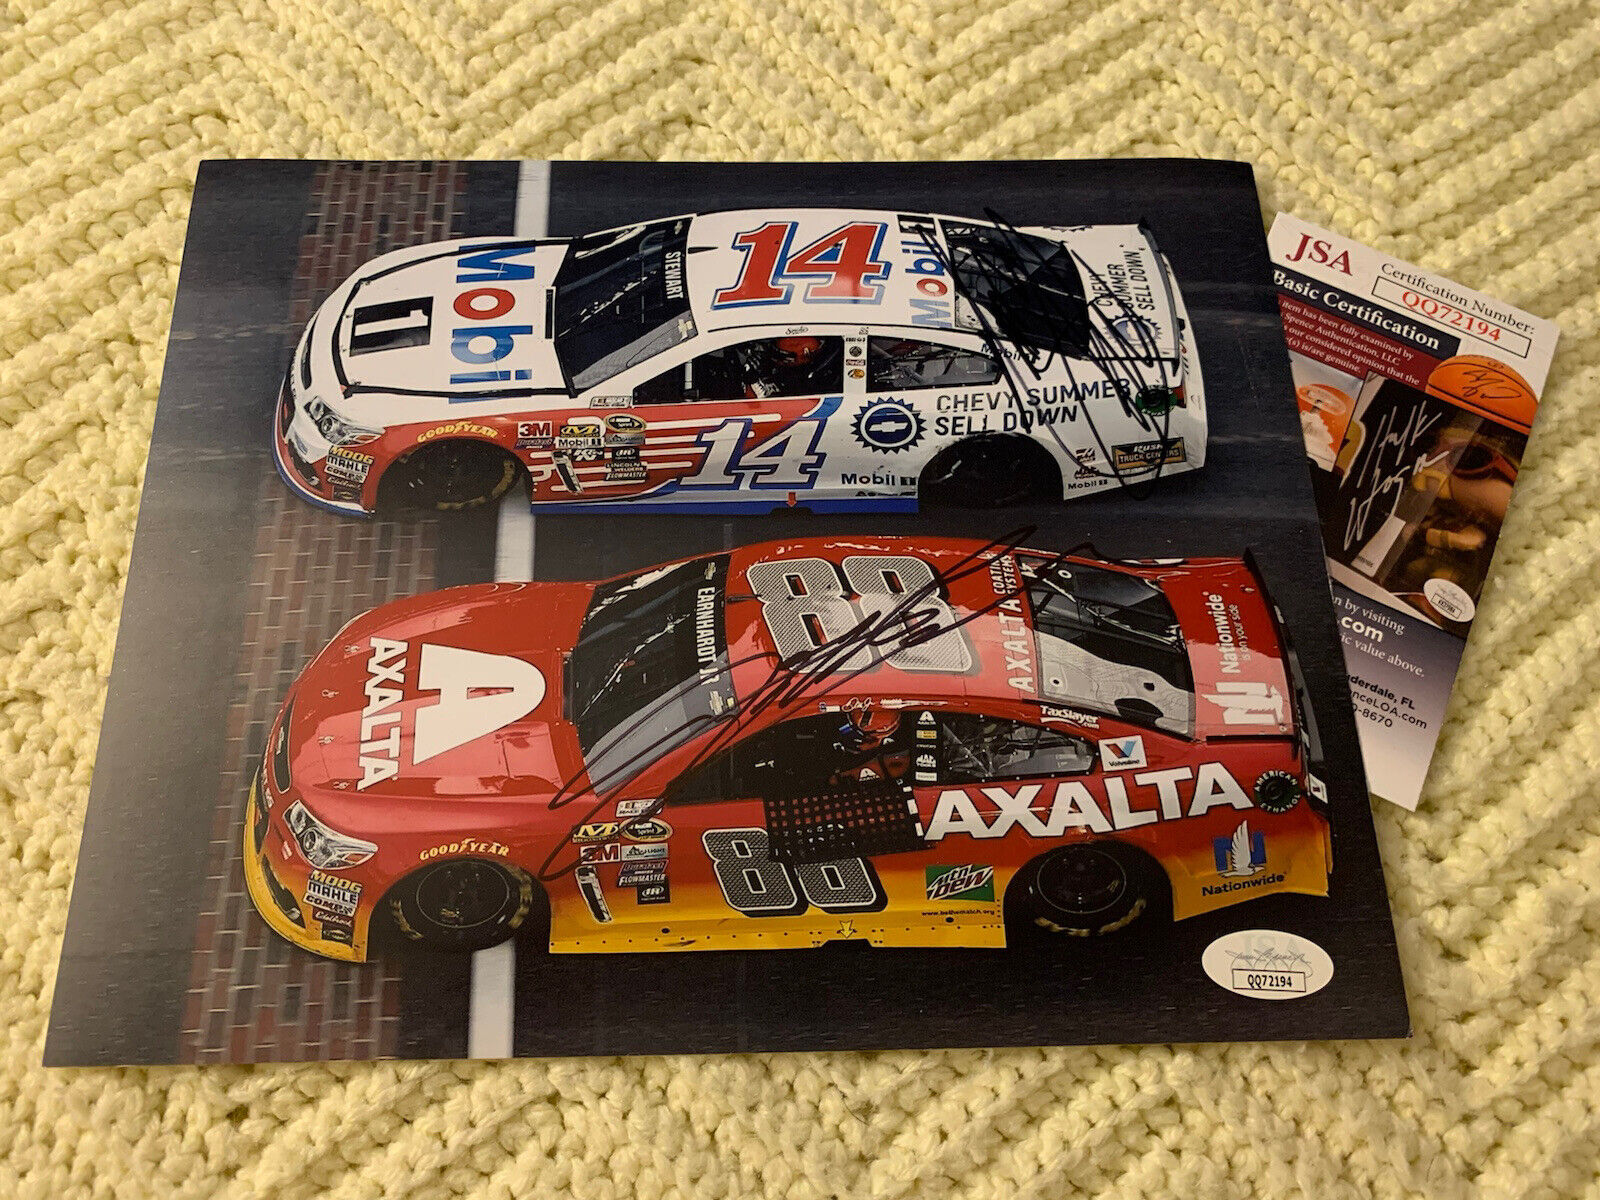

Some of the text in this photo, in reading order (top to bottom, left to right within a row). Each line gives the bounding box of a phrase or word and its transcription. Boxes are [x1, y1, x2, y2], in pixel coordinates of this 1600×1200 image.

[711, 221, 892, 310] 14
[1286, 232, 1353, 276] JSA
[664, 251, 684, 299] STEWART
[1123, 251, 1155, 311] SELL DOWN
[1273, 269, 1440, 350] Basic Certification
[1381, 263, 1536, 334] Certification Number:
[1402, 291, 1501, 341] QQ72194
[1285, 313, 1314, 330] Spence
[1381, 353, 1400, 365] LLC
[1303, 308, 1317, 320] has
[1318, 315, 1338, 328] been
[1340, 323, 1360, 338] fully
[1360, 333, 1402, 356] examined
[1403, 348, 1415, 361] by
[1289, 327, 1305, 337] our
[1305, 334, 1351, 357] considered
[1352, 351, 1385, 372] opinion
[1387, 365, 1404, 378] that
[1405, 374, 1420, 386] the
[937, 392, 1016, 413] CHEVY
[1027, 377, 1131, 406] SUMMER
[519, 423, 551, 437] 3M
[1003, 405, 1078, 432] DOWN
[331, 446, 374, 464] MOOG
[560, 438, 589, 448] Mobil
[678, 418, 828, 490] 14
[1119, 453, 1144, 463] TRUCK
[327, 456, 368, 474] MAHLE
[841, 473, 896, 486] Mobil
[1068, 480, 1097, 490] Mobil
[696, 586, 717, 662] EARNHARDT
[746, 555, 973, 674] 88
[1344, 598, 1359, 614] by
[1362, 608, 1405, 636] visiting
[998, 598, 1036, 693] AXALTA
[1205, 594, 1241, 674] Nationwide
[1355, 641, 1386, 660] value
[356, 636, 409, 791] AXALTA
[1040, 705, 1099, 724] TaxSlayer
[1401, 696, 1416, 711] FL
[1253, 769, 1298, 792] AMERICAN
[923, 762, 1255, 842] AXALTA
[1260, 794, 1301, 813] ETHANOL
[419, 838, 510, 861] GOODYEAR
[308, 881, 357, 905] MAHLE
[310, 870, 363, 893] MOOG
[618, 873, 667, 887] FLOWMASTER
[1202, 873, 1286, 897] Nationwide
[1247, 974, 1293, 988] QQ72194
